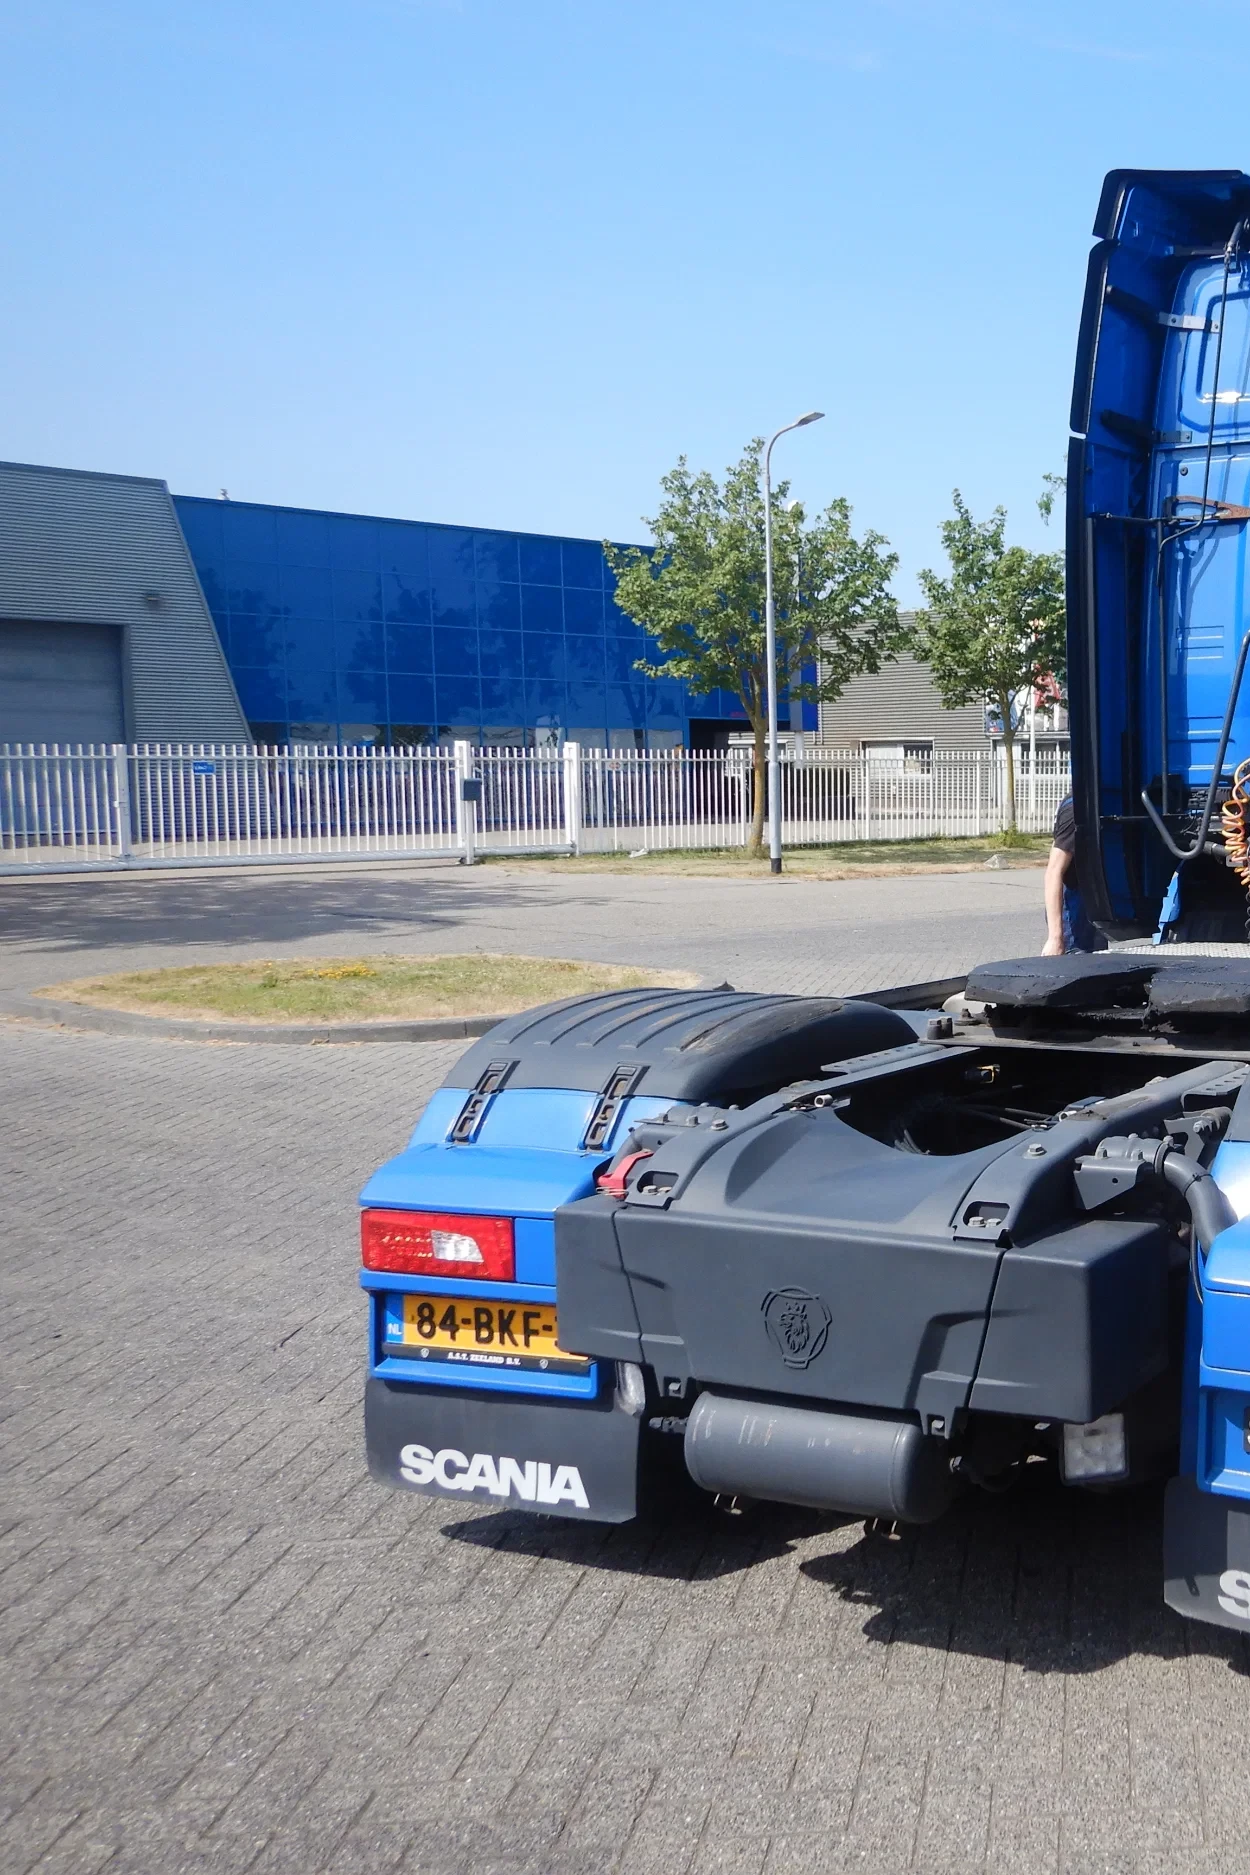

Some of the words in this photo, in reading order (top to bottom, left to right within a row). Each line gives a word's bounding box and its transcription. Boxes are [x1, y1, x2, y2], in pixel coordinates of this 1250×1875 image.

[386, 1322, 404, 1336] NL
[416, 1302, 558, 1348] 84-BKF-
[469, 1353, 504, 1364] ZEELAND
[400, 1443, 590, 1509] SCANIA
